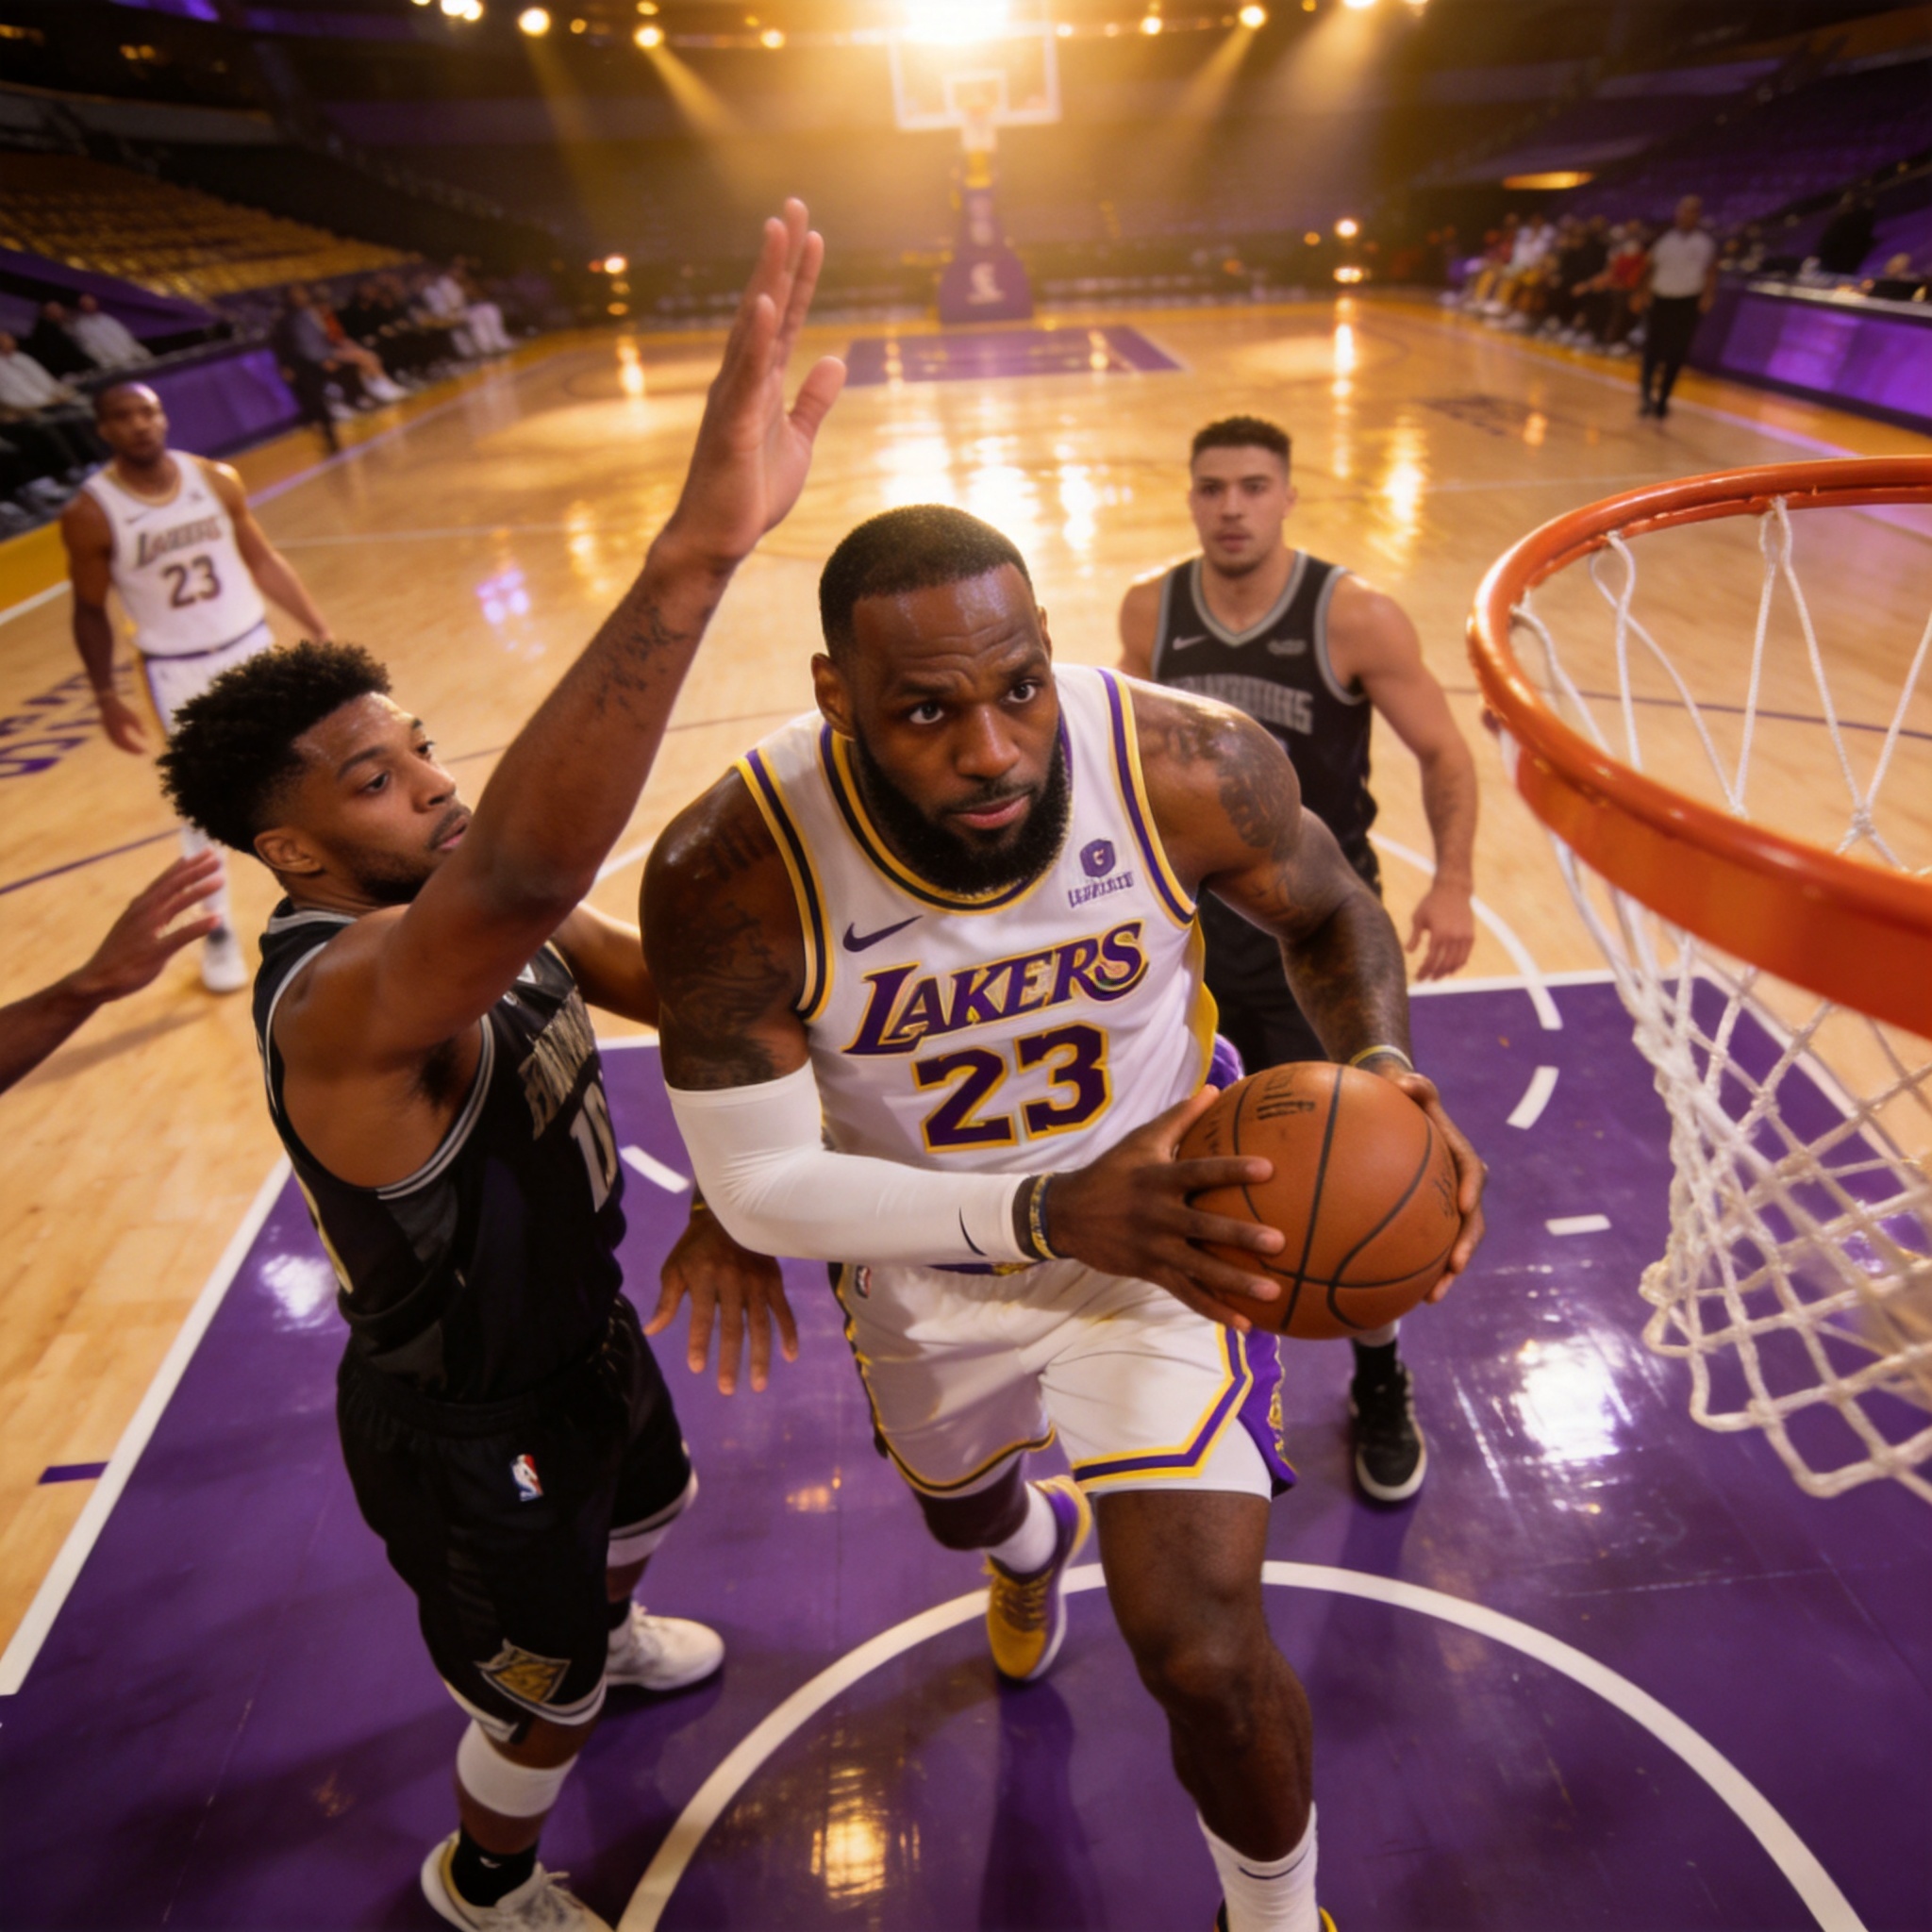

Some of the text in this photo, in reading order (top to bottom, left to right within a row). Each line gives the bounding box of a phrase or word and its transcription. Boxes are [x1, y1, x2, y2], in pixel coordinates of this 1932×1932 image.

[160, 555, 222, 609] 23
[840, 919, 1149, 1055] LAKERS
[910, 1020, 1112, 1154] 23
